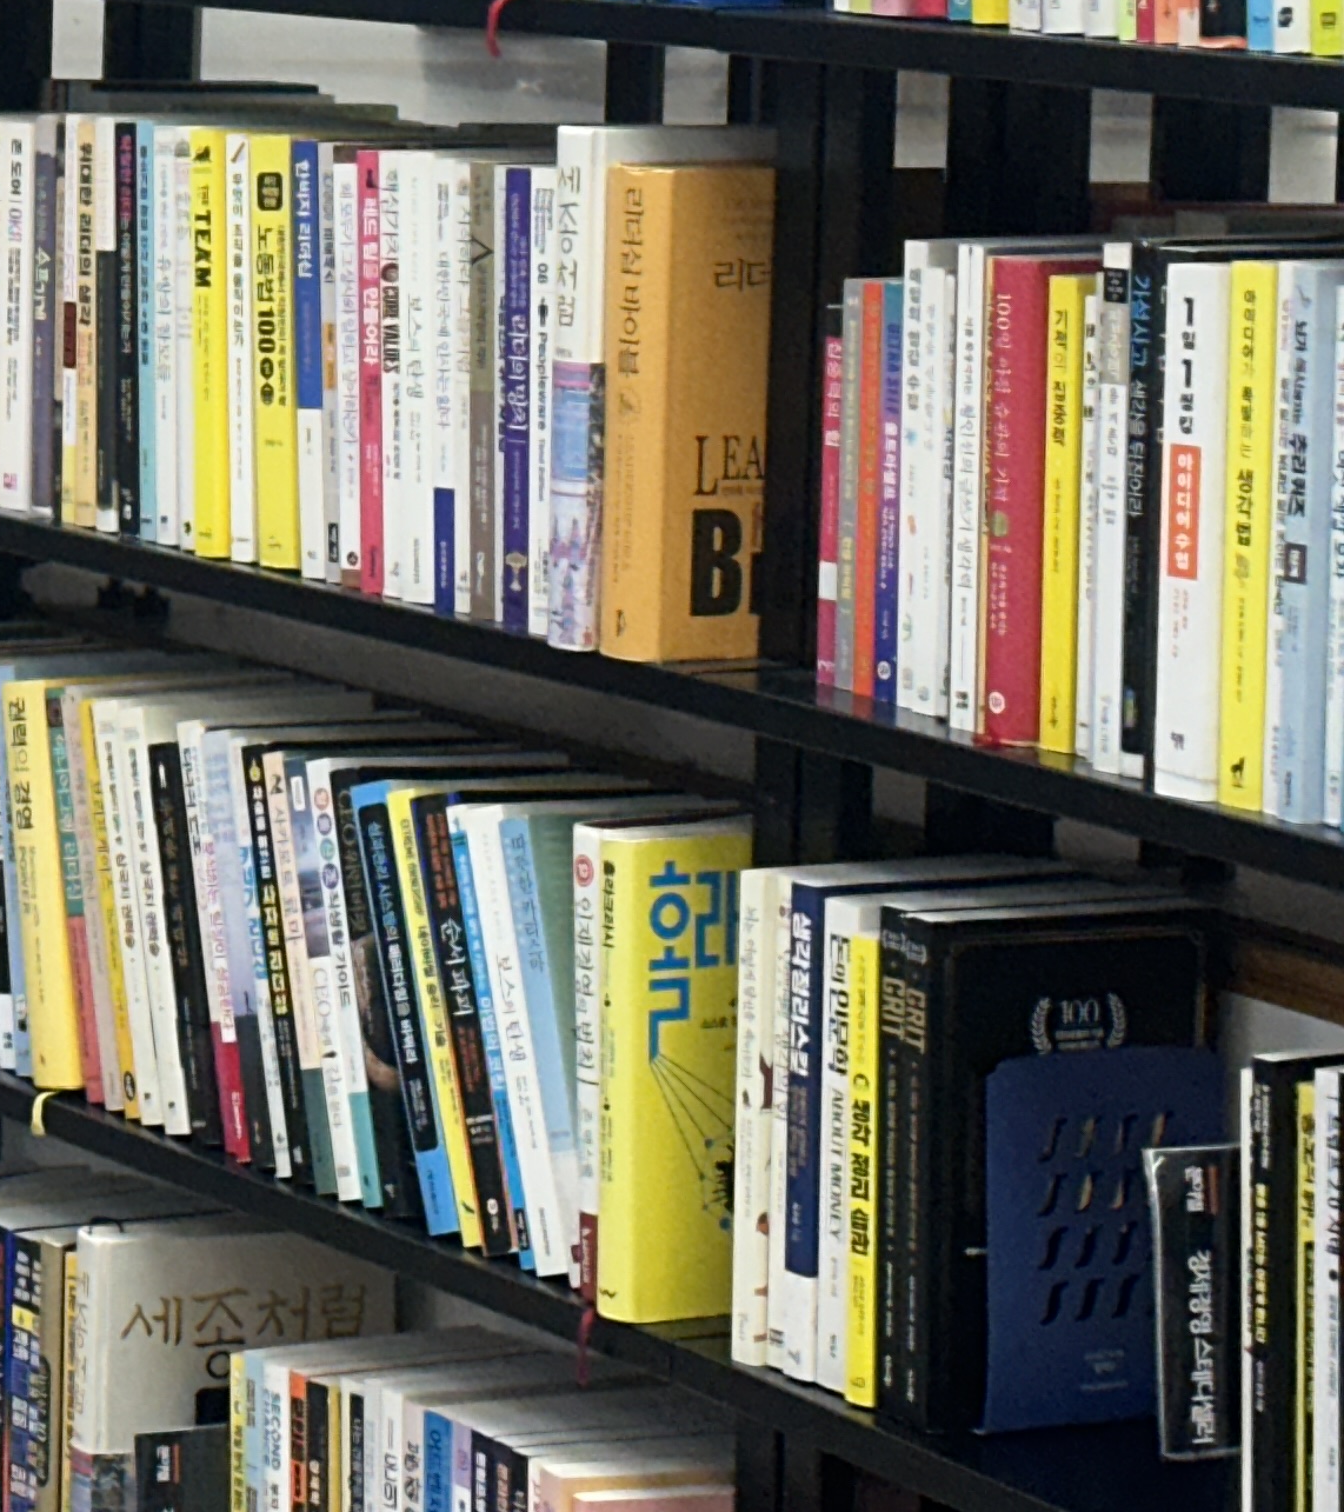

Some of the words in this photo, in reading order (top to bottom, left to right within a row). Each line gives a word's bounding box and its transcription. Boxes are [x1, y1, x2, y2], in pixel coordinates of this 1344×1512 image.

[10, 161, 22, 196] 도어
[79, 142, 93, 206] 위대한
[8, 208, 23, 243] OKR
[79, 214, 92, 278] 리더의
[194, 209, 212, 289] TEAM
[297, 223, 312, 279] 리더십
[621, 187, 645, 277] 리더십
[257, 225, 274, 303] 노동법
[79, 285, 92, 327] 생각
[618, 286, 640, 376] 바이블
[383, 325, 399, 374] VALUES
[407, 361, 424, 399] 탄생
[537, 331, 548, 431] Peopleware
[1289, 433, 1308, 474] 추리
[1288, 477, 1307, 518] 퀴즈
[9, 697, 28, 772] 권력의
[14, 781, 34, 830] 경영
[18, 846, 31, 915] POWER
[441, 918, 467, 966] 순서
[335, 952, 351, 1008] 가이드
[450, 969, 473, 1018] 파괴
[792, 912, 811, 1077] 생각정리스킬
[881, 977, 905, 1039] GRIT
[828, 989, 849, 1077] 인문학
[905, 987, 926, 1054] GRIT
[831, 1088, 844, 1159] ABOUT
[830, 1163, 841, 1240] MONEY
[119, 1282, 369, 1382] 세종처럼
[1190, 1337, 1215, 1445] 스테디셀러
[270, 1390, 282, 1471] SECOND
